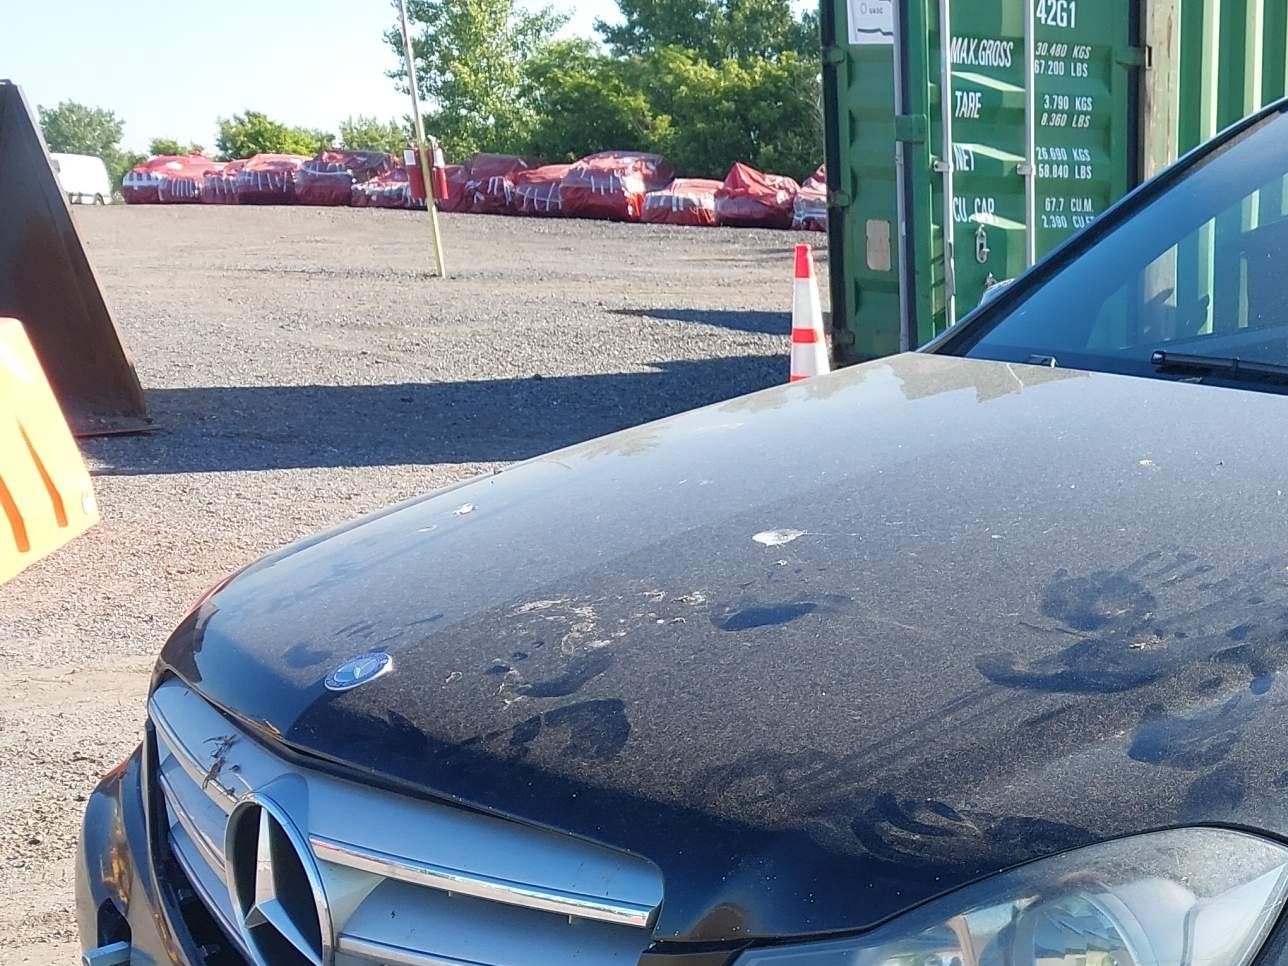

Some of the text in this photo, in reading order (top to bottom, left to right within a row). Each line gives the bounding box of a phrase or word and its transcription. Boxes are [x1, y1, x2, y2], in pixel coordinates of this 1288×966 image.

[1036, 0, 1076, 28] 42G1
[950, 37, 1091, 68] MAX.GROSS 30.480 KGS
[1034, 59, 1088, 77] 67.200 LBS
[955, 91, 982, 118] TARE
[1075, 96, 1093, 111] KGS
[1040, 112, 1091, 128] 8.360 LBS
[953, 143, 975, 171] NET
[1071, 148, 1091, 161] KGS
[1074, 165, 1092, 179] LBS
[1044, 197, 1064, 212] 67.7
[1041, 215, 1068, 228] 2.390
